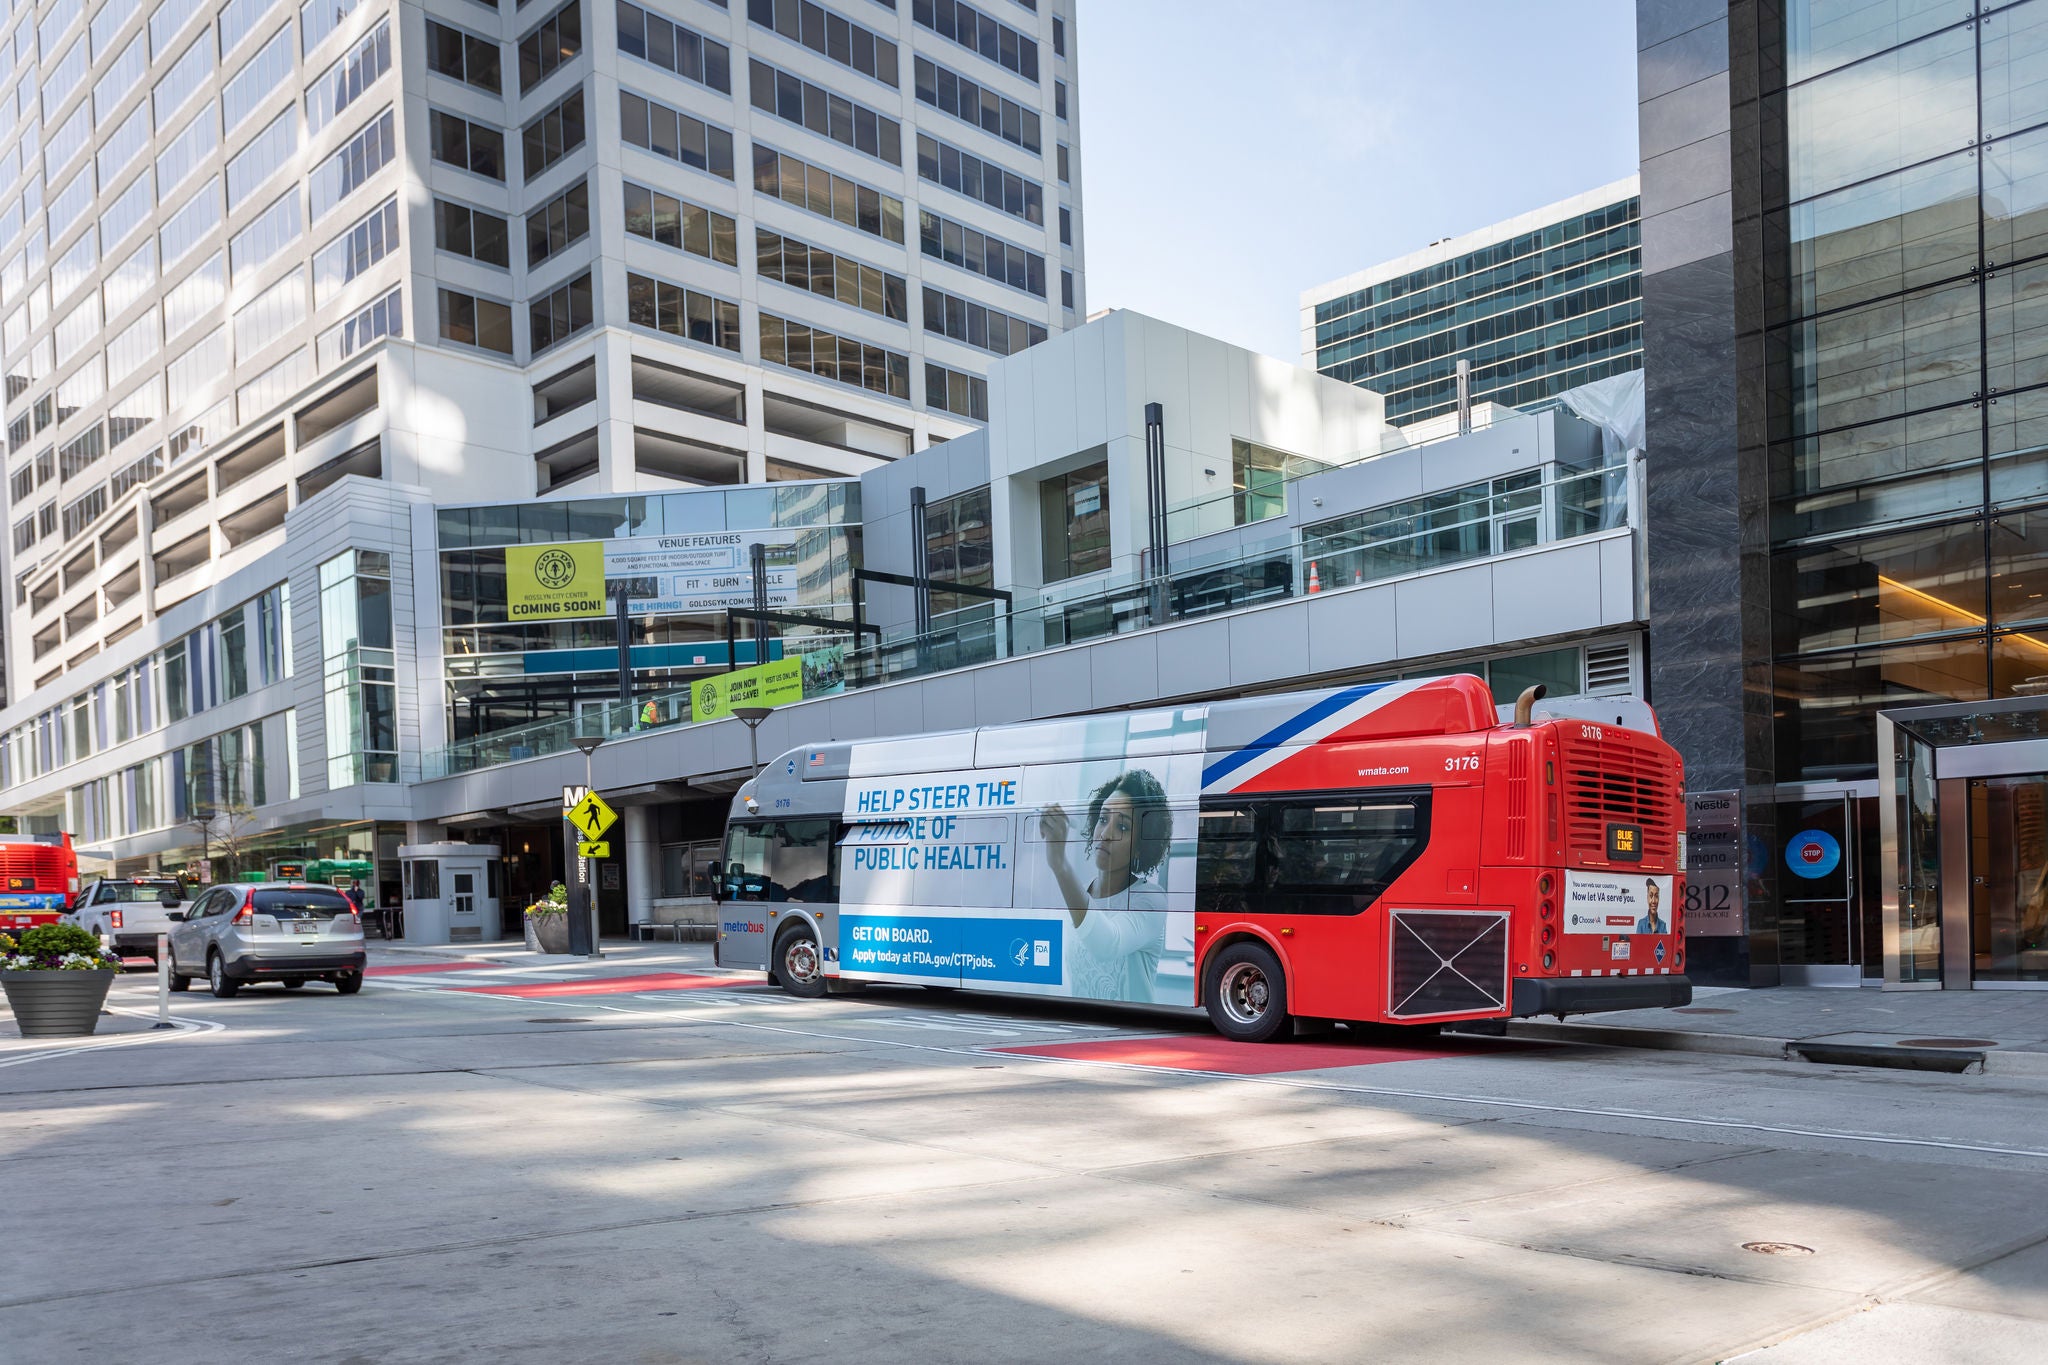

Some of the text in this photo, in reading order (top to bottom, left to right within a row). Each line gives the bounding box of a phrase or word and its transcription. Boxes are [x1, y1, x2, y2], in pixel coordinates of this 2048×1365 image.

[658, 535, 741, 548] VENUE FEATURES
[538, 552, 572, 571] GOLD'S
[669, 552, 713, 560] INDOOR/OUTDOOR
[542, 574, 570, 587] GYM
[686, 579, 699, 589] FIT
[712, 577, 739, 588] BURN
[524, 591, 588, 601] ROSSLYN CITY CENTER
[513, 600, 601, 615] COMING SOON!
[646, 600, 682, 610] HIRING!
[765, 676, 776, 684] VISIT
[782, 670, 798, 680] ONLINE
[730, 677, 757, 692] JOIN NOW
[730, 692, 742, 703] AND
[742, 688, 759, 700] SAVE!
[1581, 724, 1602, 740] 3176
[1444, 756, 1479, 771] 3176
[1358, 765, 1409, 777] wmata.com
[857, 780, 1017, 813] HELP STEER THE
[775, 798, 790, 809] 3176
[931, 815, 957, 840] OF
[1616, 829, 1633, 841] BLUE
[1690, 832, 1728, 841] Cerner
[1616, 841, 1633, 852] LINE
[854, 845, 1006, 871] PUBLIC HEALTH.
[1572, 891, 1636, 904] Now let VA serve you.
[723, 920, 765, 933] metrobus
[852, 926, 933, 944] GET ON BOARD.
[1035, 945, 1049, 953] FDA
[852, 948, 996, 970] Apply today at FDA.gov/CTPjobs.
